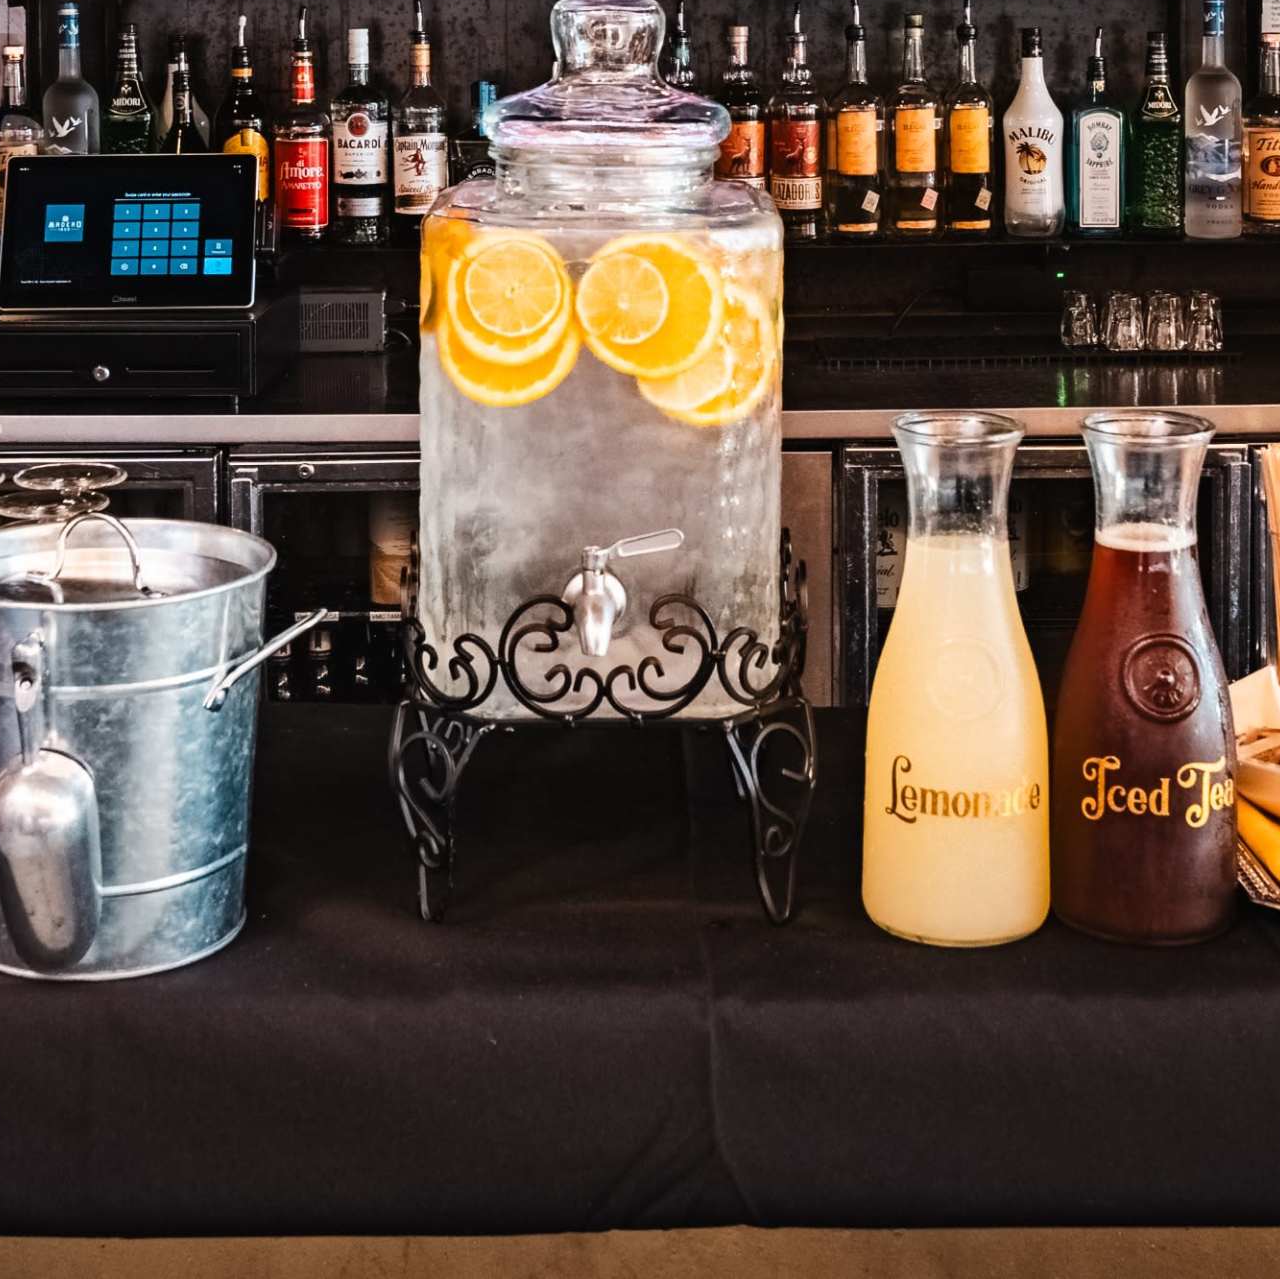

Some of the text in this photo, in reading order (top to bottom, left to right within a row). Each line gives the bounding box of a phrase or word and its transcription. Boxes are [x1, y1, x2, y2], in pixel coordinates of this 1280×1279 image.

[112, 98, 141, 107] MIDORI
[1087, 121, 1112, 131] BOMBAY
[337, 138, 381, 149] BACARDÍ
[1008, 127, 1056, 145] MALIBU
[280, 165, 324, 181] Amore
[885, 755, 1041, 824] Lemonade
[1081, 756, 1234, 829] Iced Tea
